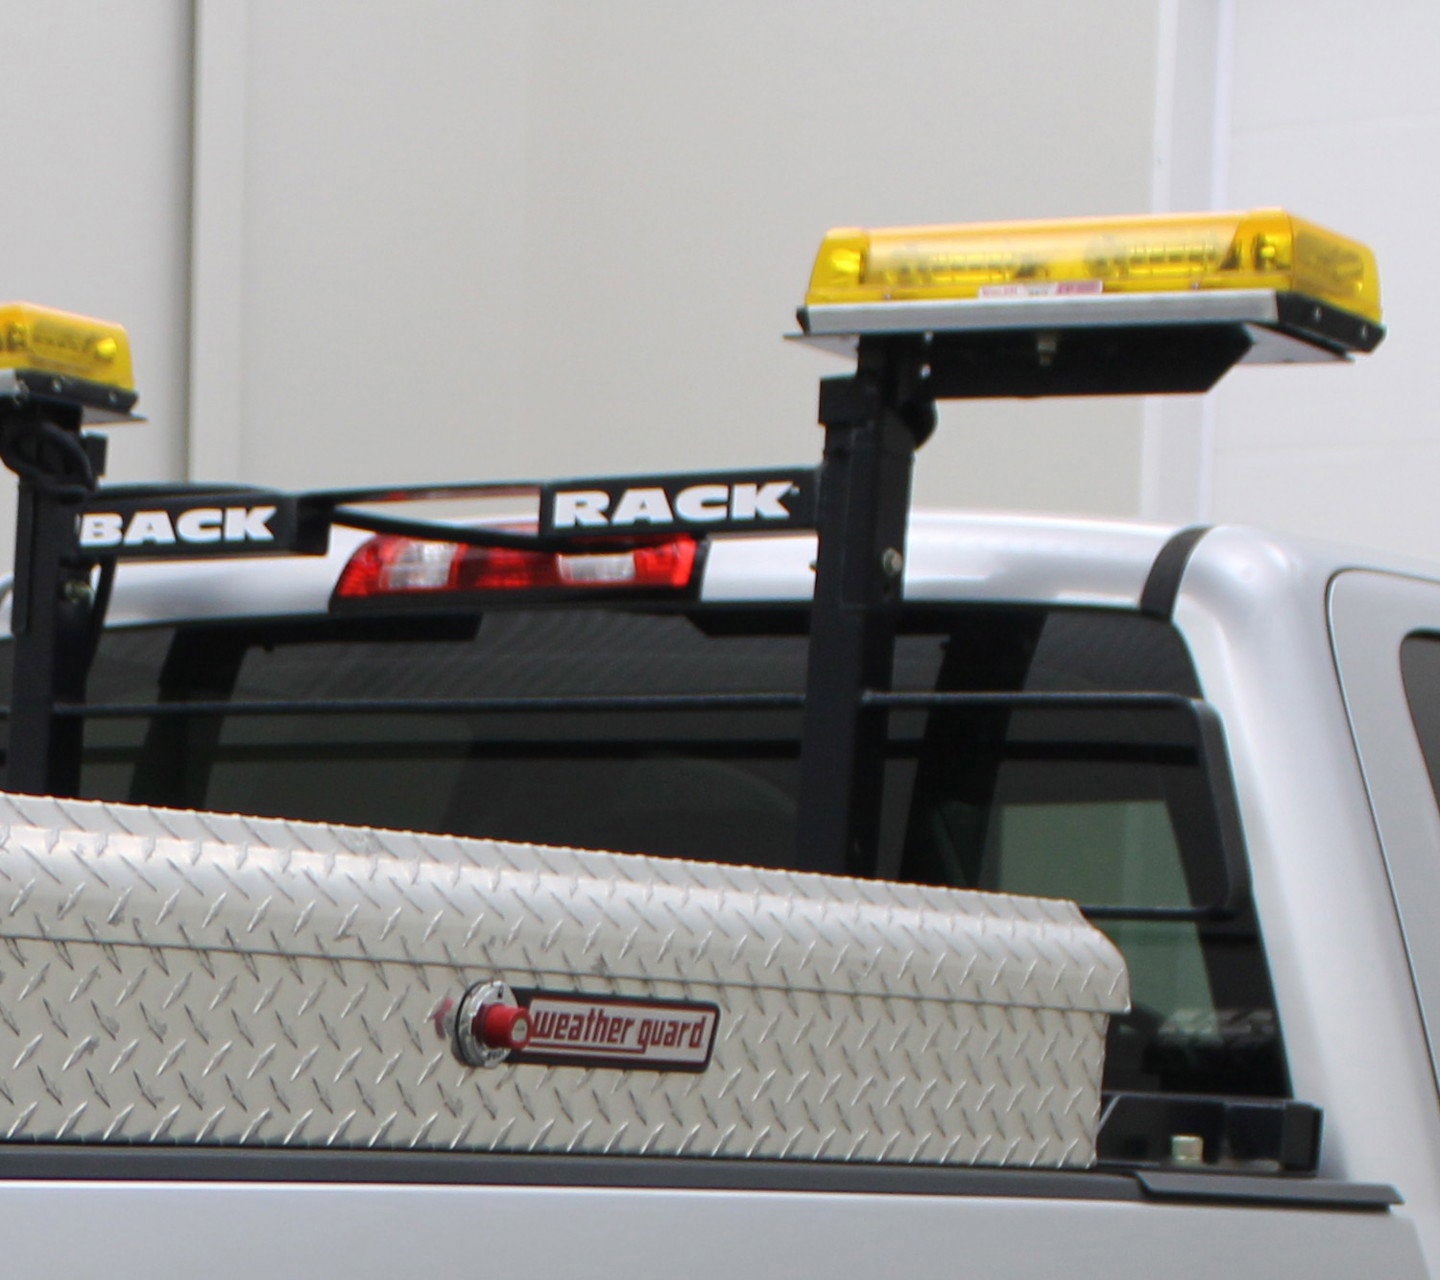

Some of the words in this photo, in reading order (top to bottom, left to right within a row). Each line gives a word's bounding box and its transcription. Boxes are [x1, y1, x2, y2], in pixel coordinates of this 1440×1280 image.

[79, 506, 277, 548] BACK
[553, 480, 794, 528] RACK
[532, 1008, 635, 1044] weather
[637, 1016, 706, 1054] guard
